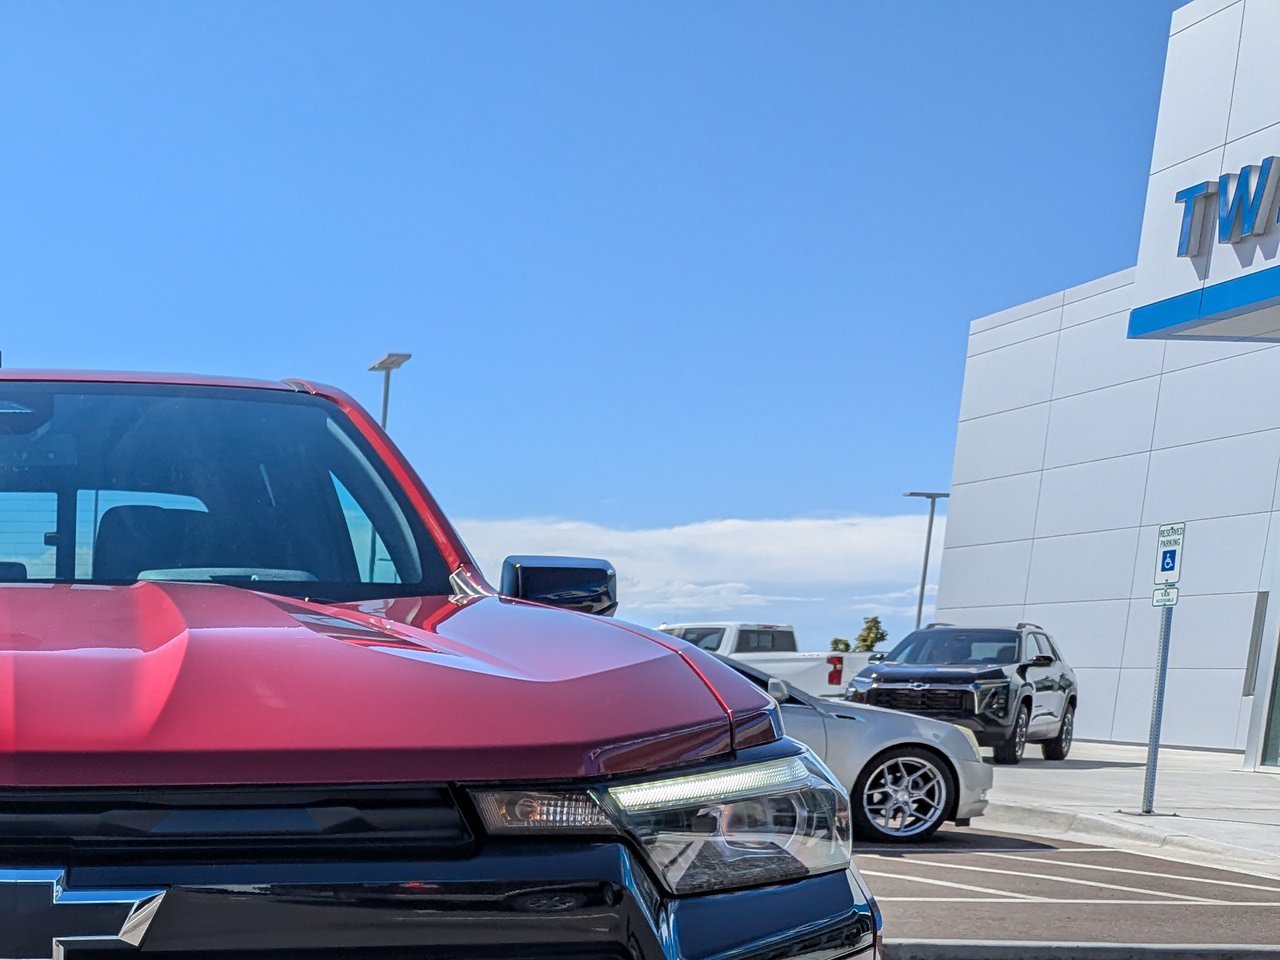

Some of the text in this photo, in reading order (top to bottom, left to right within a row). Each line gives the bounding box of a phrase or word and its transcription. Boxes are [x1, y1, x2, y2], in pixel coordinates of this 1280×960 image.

[1175, 156, 1280, 258] TW
[1160, 527, 1184, 538] RESERVED
[1160, 538, 1181, 548] PARKING
